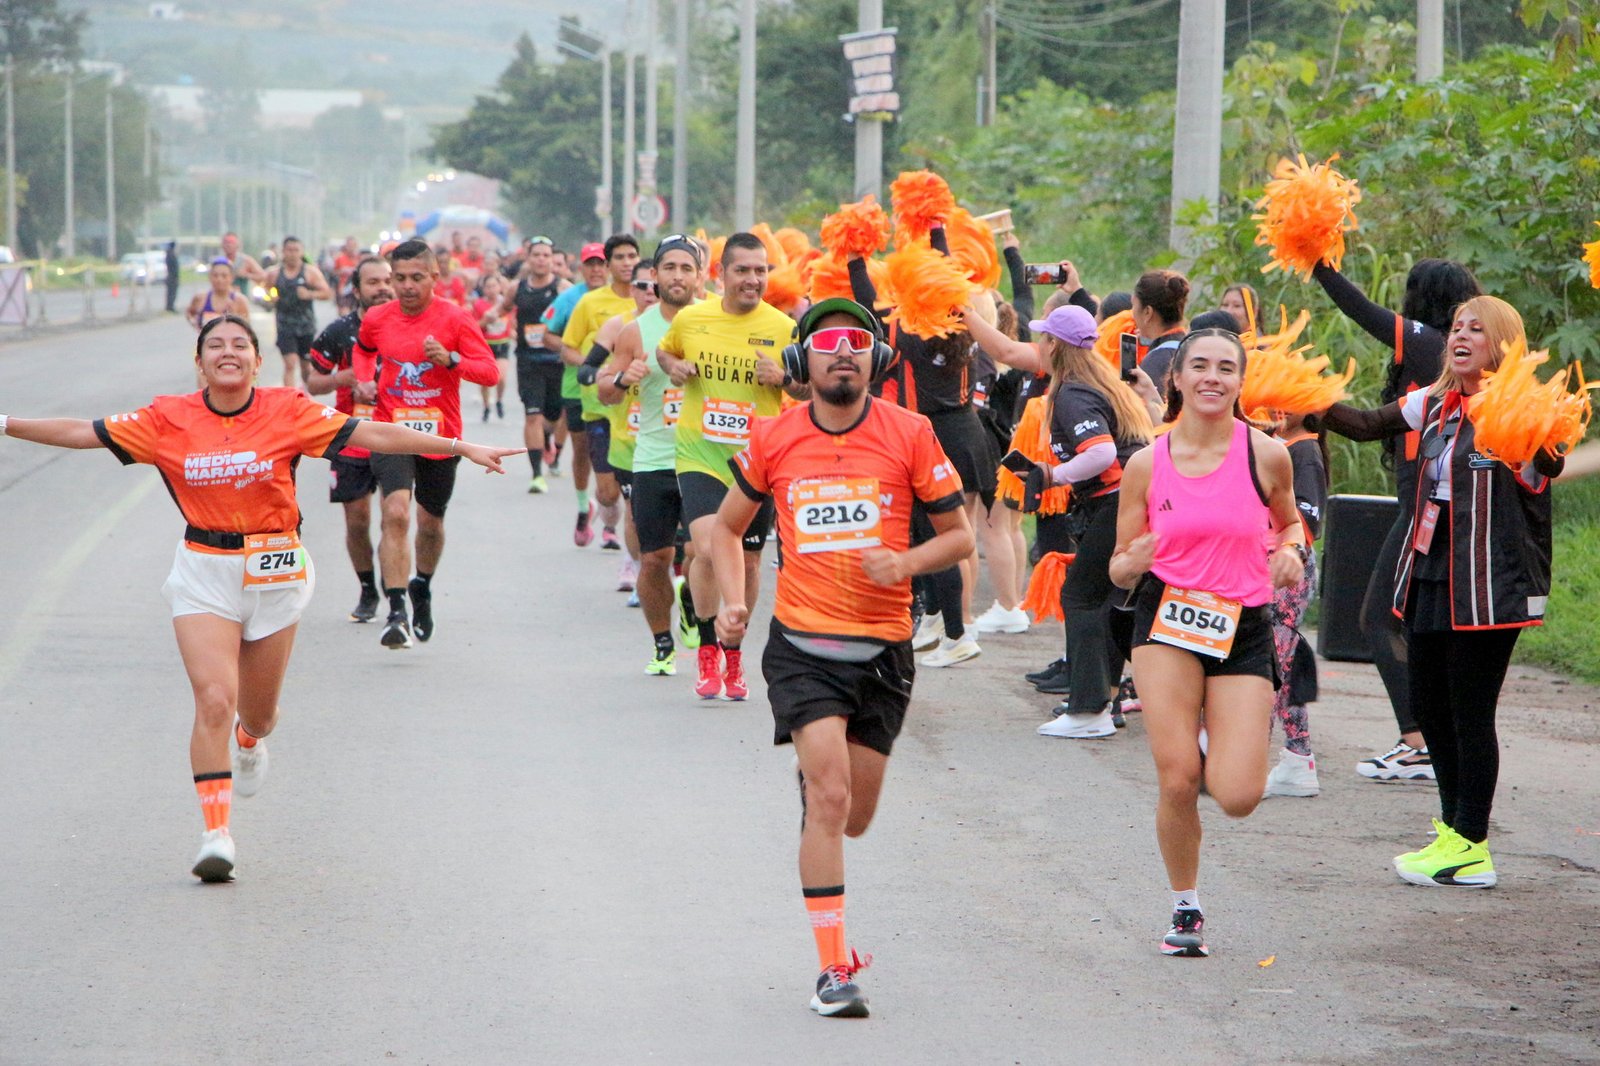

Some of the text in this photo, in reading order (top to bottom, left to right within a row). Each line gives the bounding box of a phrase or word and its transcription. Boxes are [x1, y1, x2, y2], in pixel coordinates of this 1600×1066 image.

[708, 413, 747, 429] 1329
[806, 504, 868, 526] 2216
[260, 552, 296, 570] 274
[1164, 602, 1227, 634] 1054
